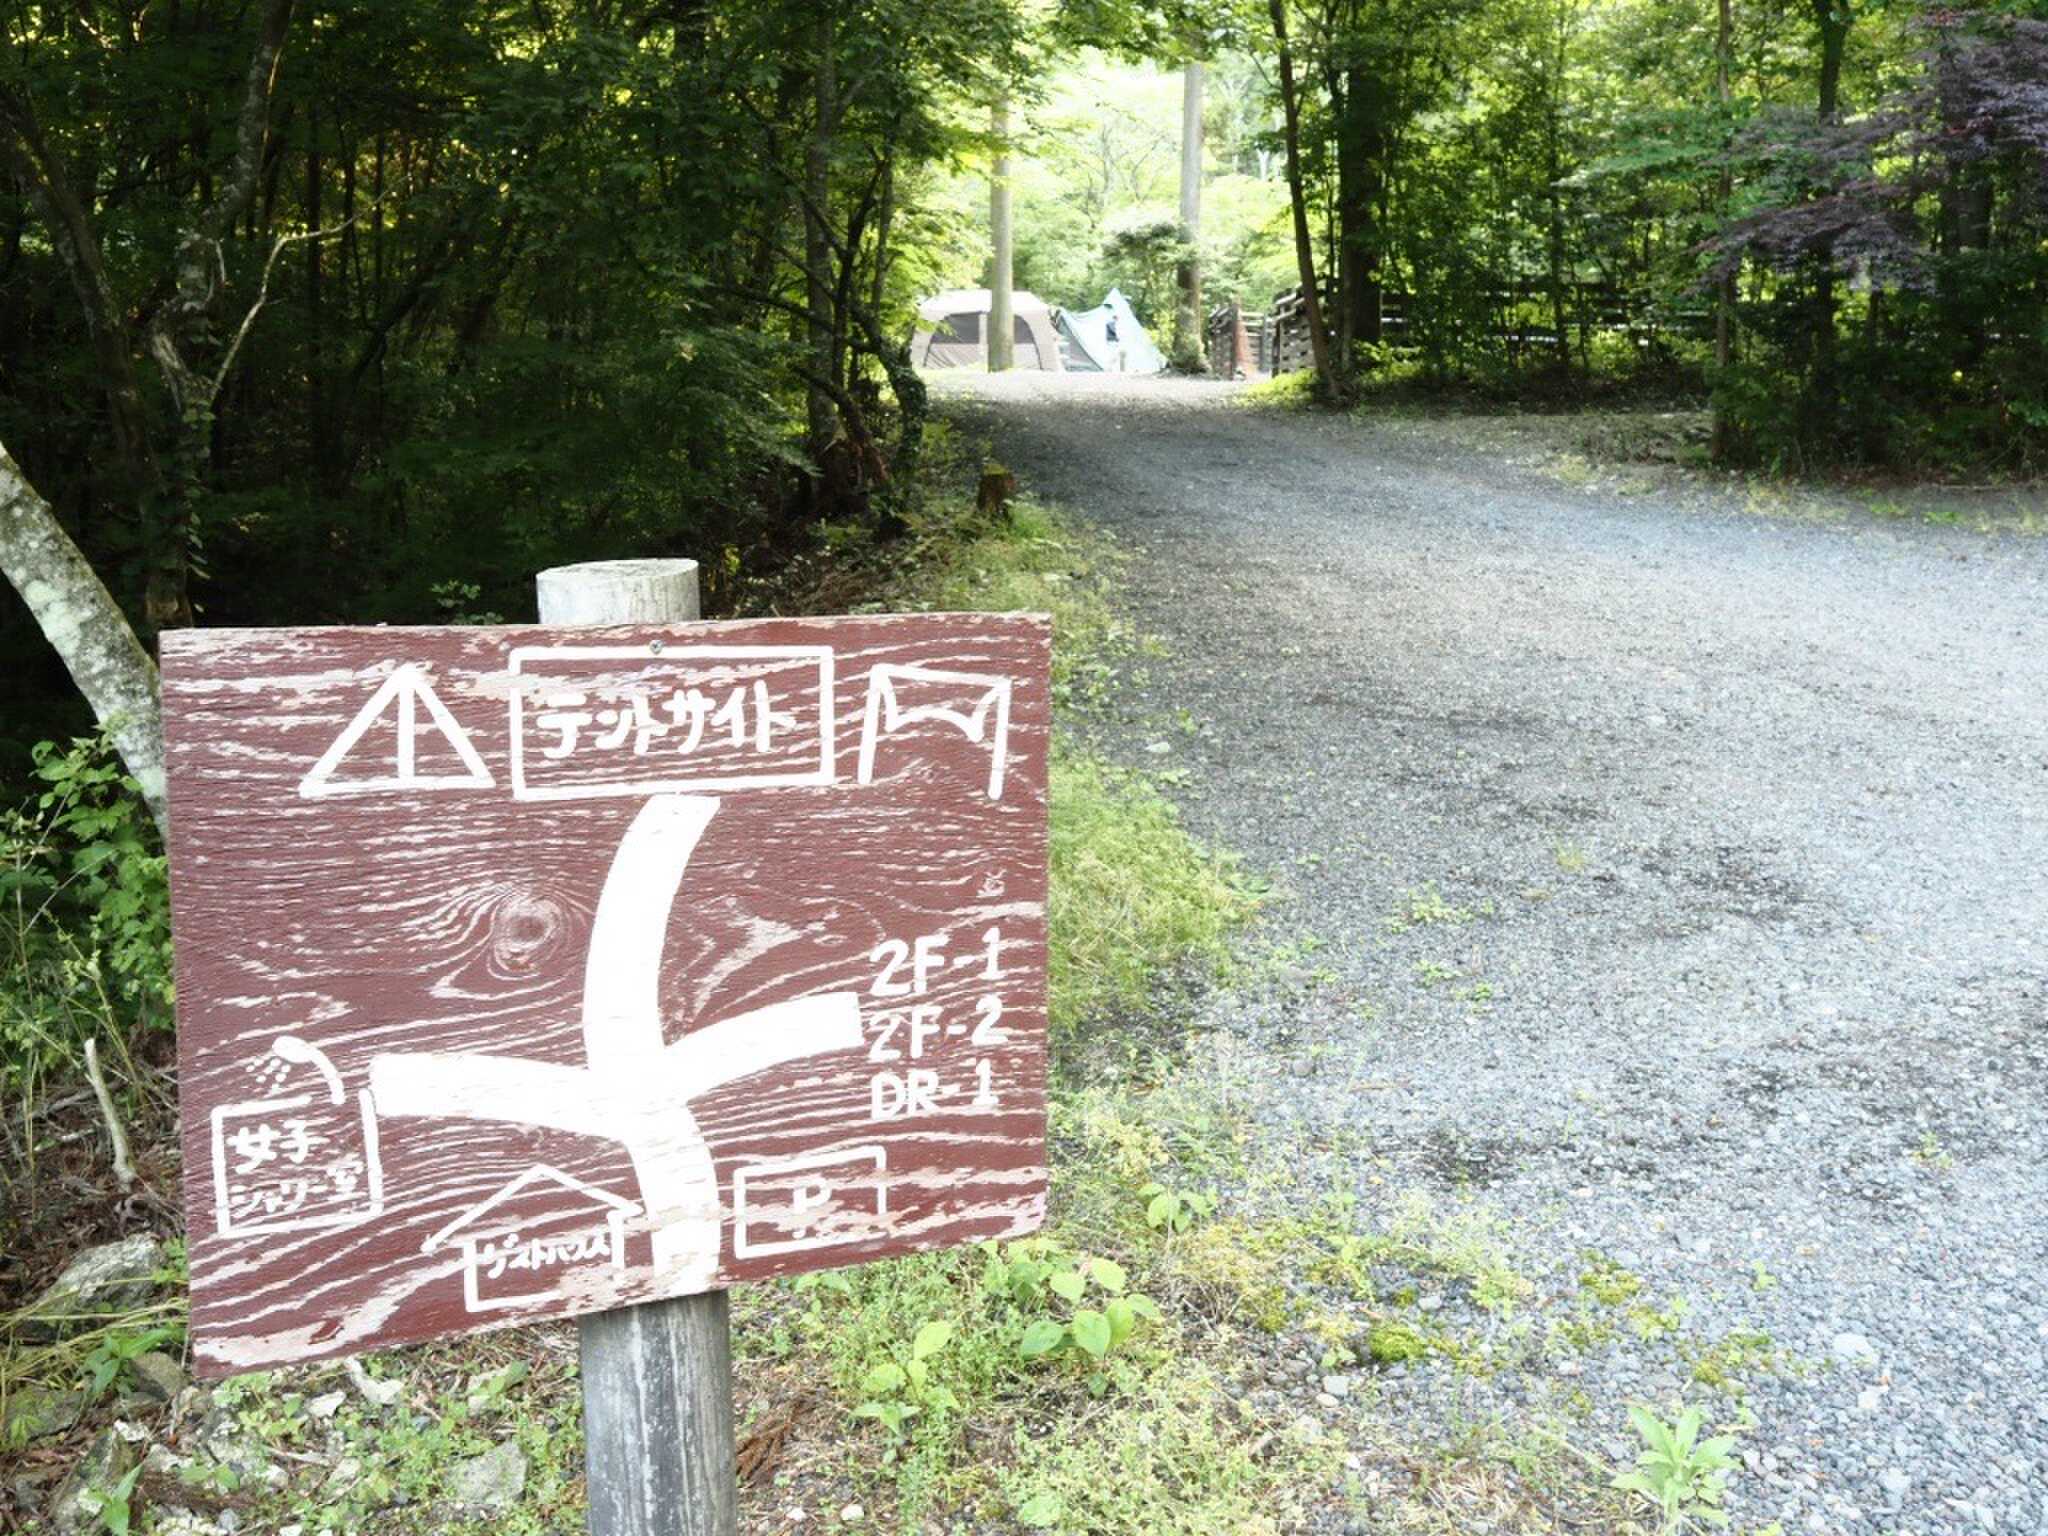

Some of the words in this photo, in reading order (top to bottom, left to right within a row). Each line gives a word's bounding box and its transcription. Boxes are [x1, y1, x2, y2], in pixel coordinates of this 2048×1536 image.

[537, 680, 797, 759] テントサイト
[869, 927, 1002, 997] 2F-1
[868, 993, 1008, 1063] 2F-2
[870, 1058, 1000, 1120] DR-1
[226, 1119, 330, 1175] 女子
[791, 1175, 834, 1239] P
[480, 1232, 612, 1279] ゲストハウス
